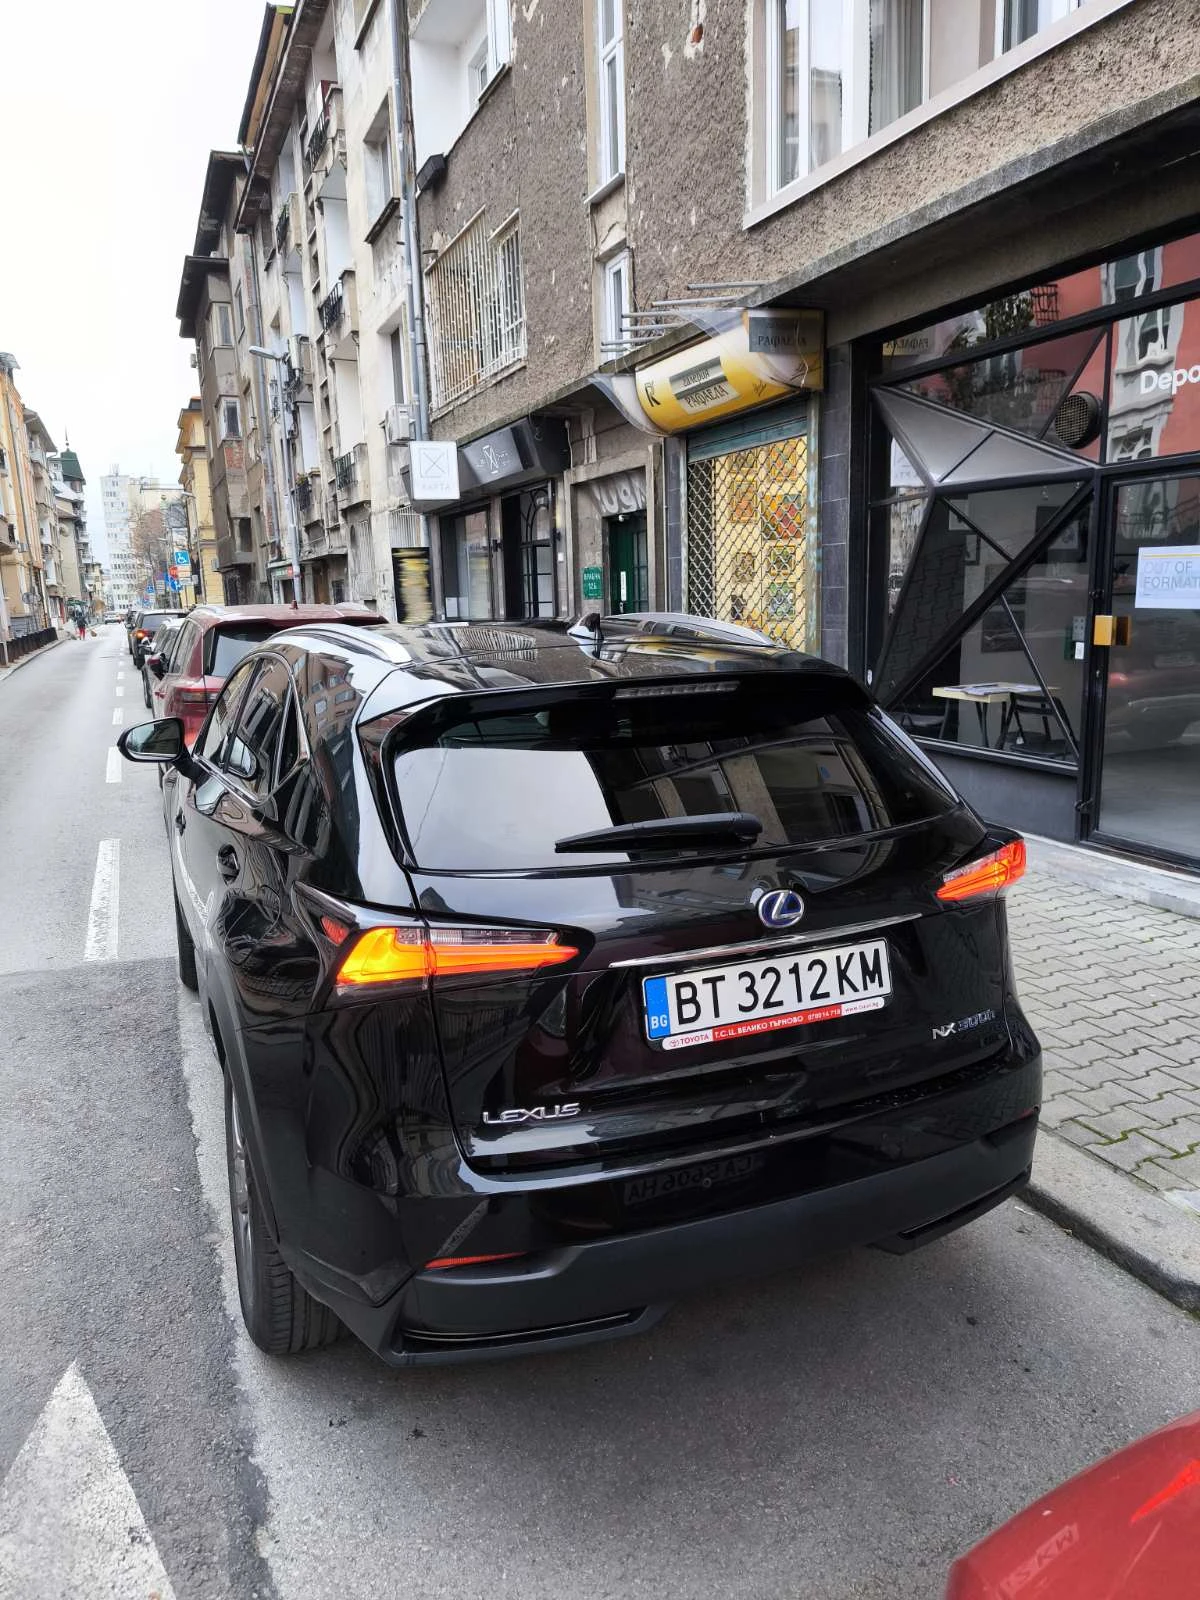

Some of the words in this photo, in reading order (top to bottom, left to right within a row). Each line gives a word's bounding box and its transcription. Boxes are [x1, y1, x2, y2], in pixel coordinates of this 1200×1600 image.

[1175, 561, 1192, 574] OF
[675, 975, 726, 1025] BT
[738, 958, 830, 1013] 3212
[836, 948, 884, 996] KM
[651, 1014, 668, 1029] BG
[681, 1033, 709, 1045] TOYOTA
[738, 1022, 768, 1034] ВЕЛИКО
[770, 1016, 803, 1027] ТЪРНОВО
[932, 1022, 957, 1040] NX
[482, 1103, 580, 1124] LEXUS
